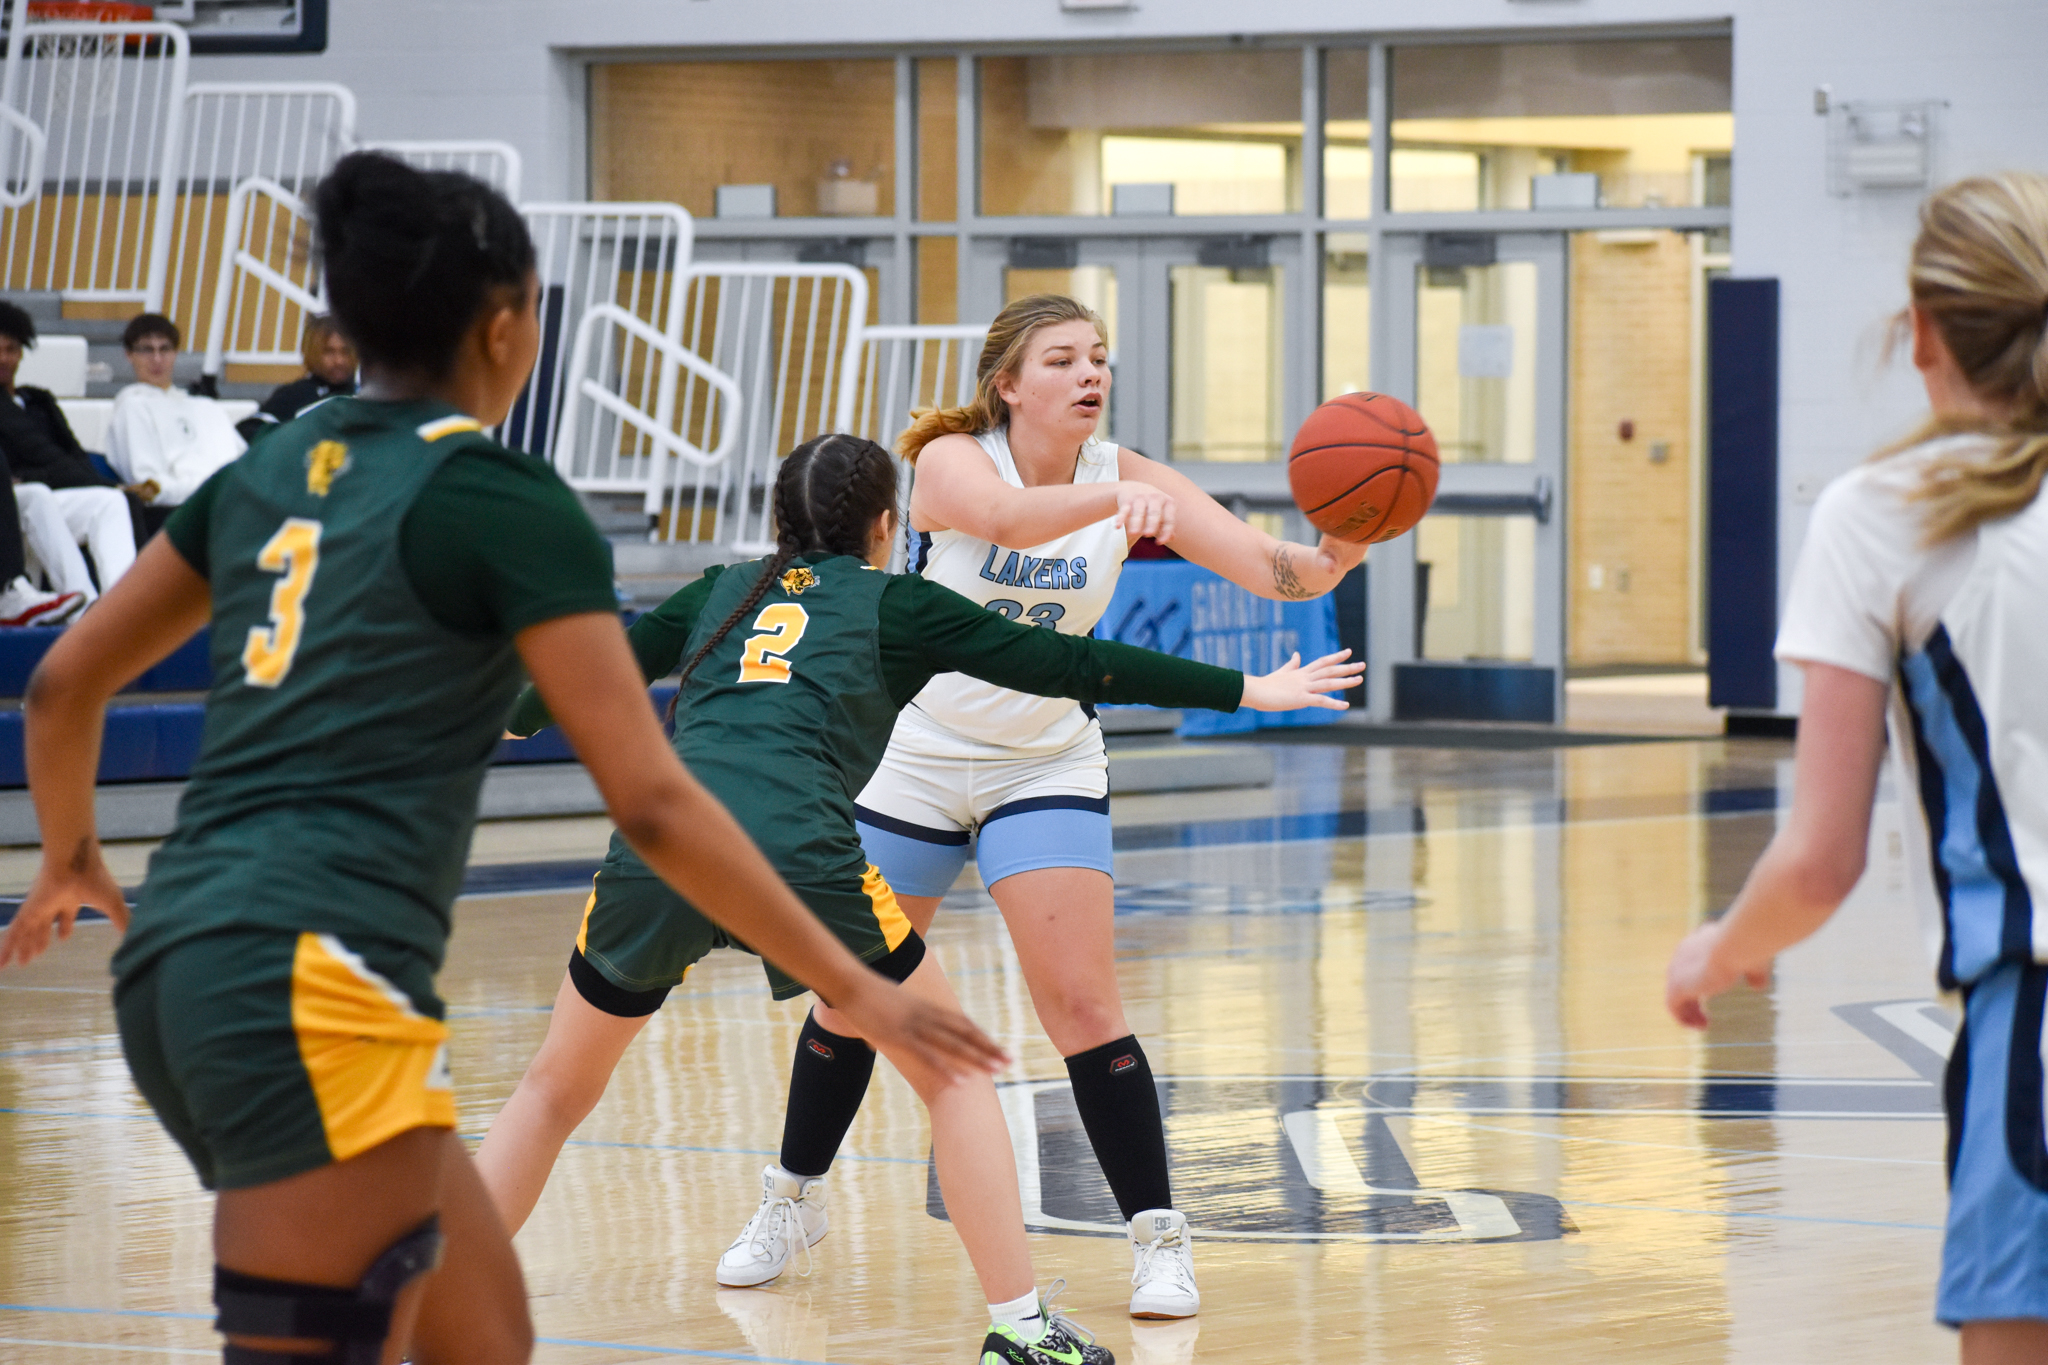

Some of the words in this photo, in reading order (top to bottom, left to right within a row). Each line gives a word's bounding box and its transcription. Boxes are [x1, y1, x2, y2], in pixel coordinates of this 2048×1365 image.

[241, 516, 323, 689] 3
[979, 544, 1088, 590] LAKERS
[736, 602, 809, 684] 2
